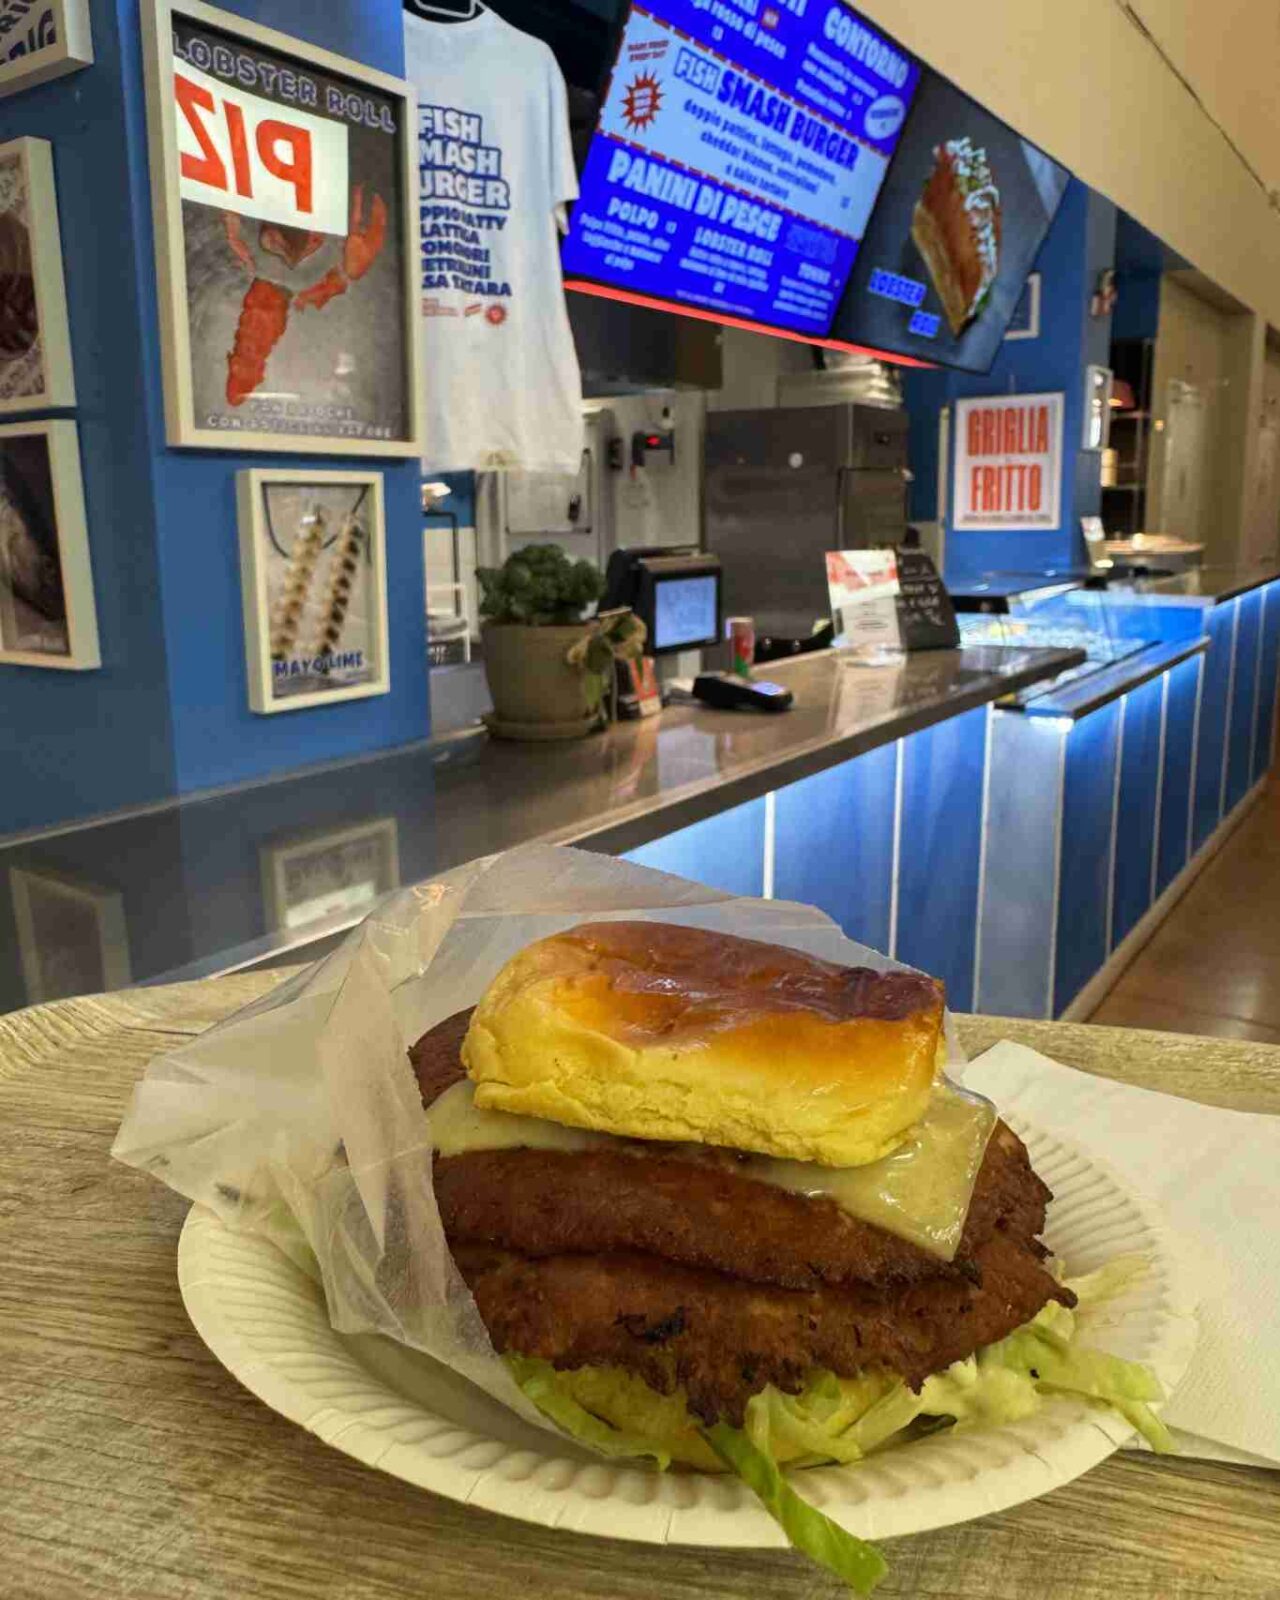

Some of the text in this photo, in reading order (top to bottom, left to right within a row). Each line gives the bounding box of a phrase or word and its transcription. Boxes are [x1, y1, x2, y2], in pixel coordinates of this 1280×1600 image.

[823, 6, 910, 90] CONTORNO
[173, 32, 397, 134] LOBSTER ROLL
[418, 105, 482, 145] FISH
[676, 48, 720, 95] FISH
[716, 69, 792, 137] SMASH
[789, 111, 860, 172] BURGER
[419, 137, 501, 178] MASH
[419, 168, 510, 210] URGER
[607, 148, 700, 212] PANINI
[694, 183, 724, 221] DI
[719, 193, 784, 243] PESCE
[420, 206, 461, 221] PPIO
[607, 197, 659, 230] POLPO
[693, 225, 748, 258] LOBSTER
[421, 274, 449, 290] SA
[967, 406, 1049, 457] GRIGLIA
[970, 464, 1042, 512] FRITTO
